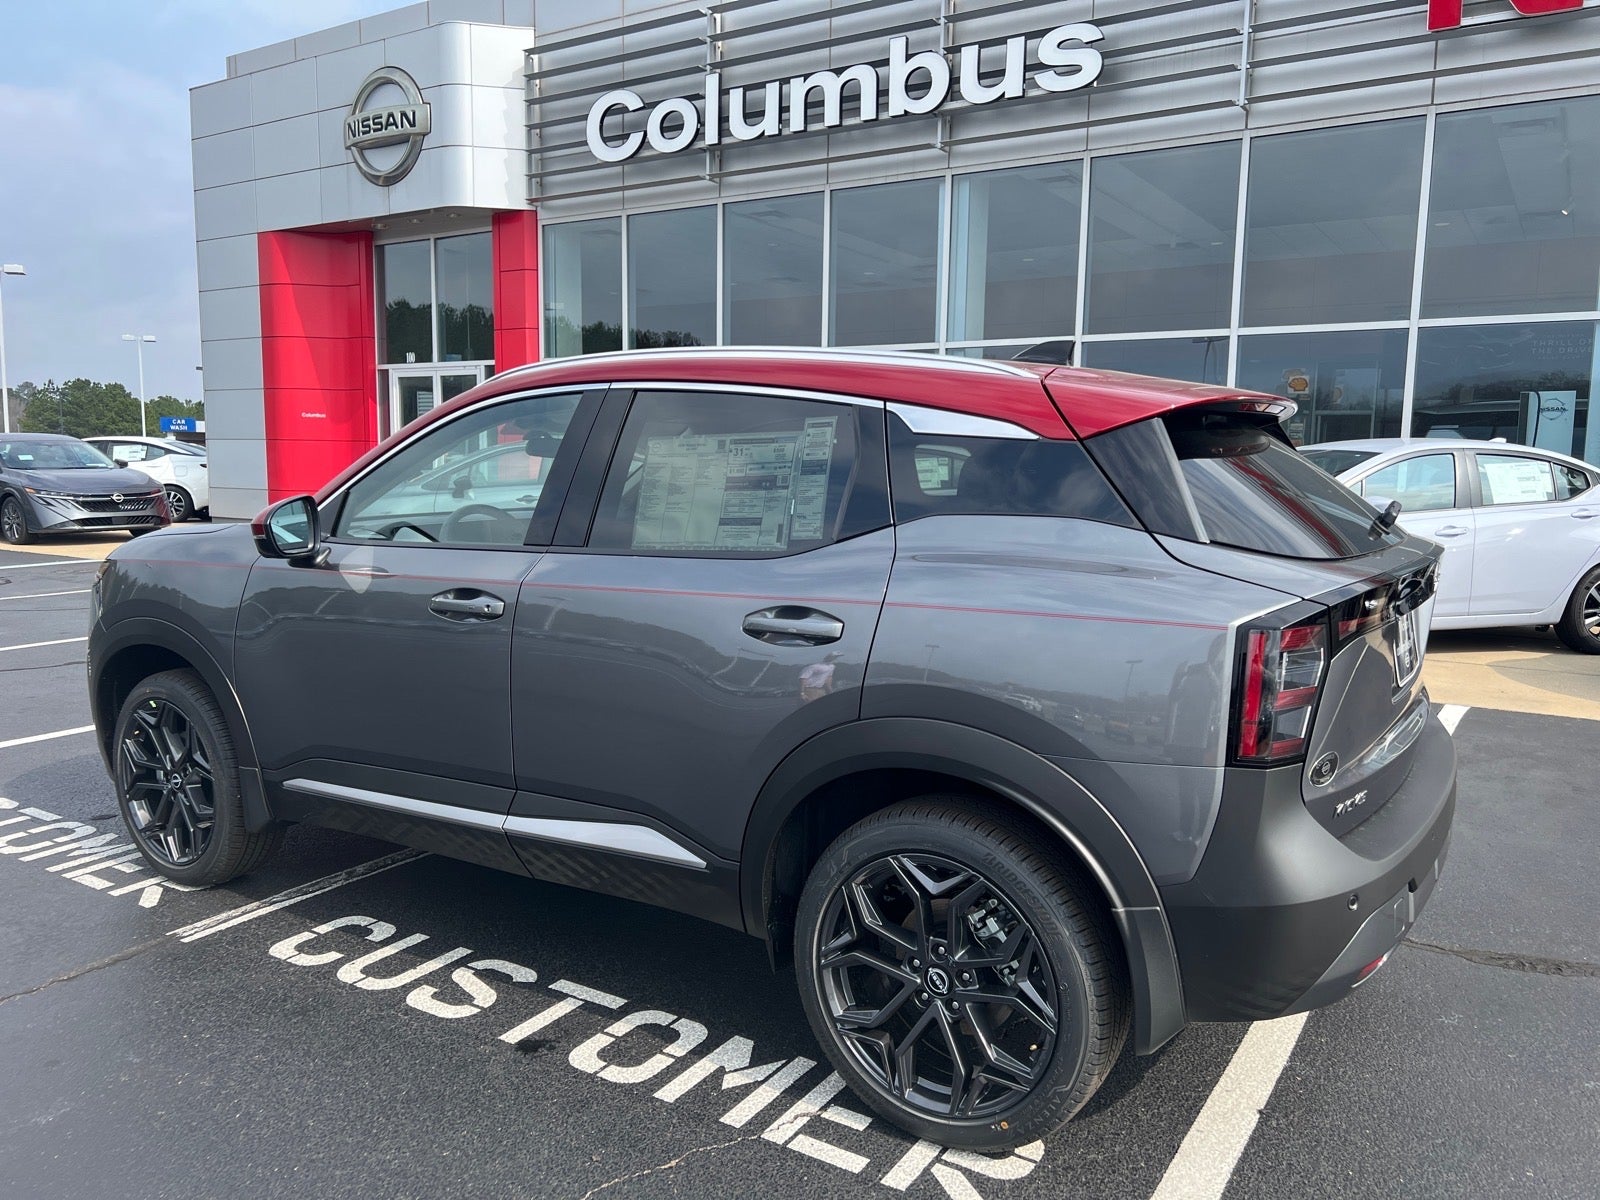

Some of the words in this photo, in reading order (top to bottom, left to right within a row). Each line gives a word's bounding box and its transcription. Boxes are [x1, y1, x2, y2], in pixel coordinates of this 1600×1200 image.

[585, 22, 1106, 164] Columbus
[347, 110, 416, 140] NISSAN
[406, 351, 416, 363] 100
